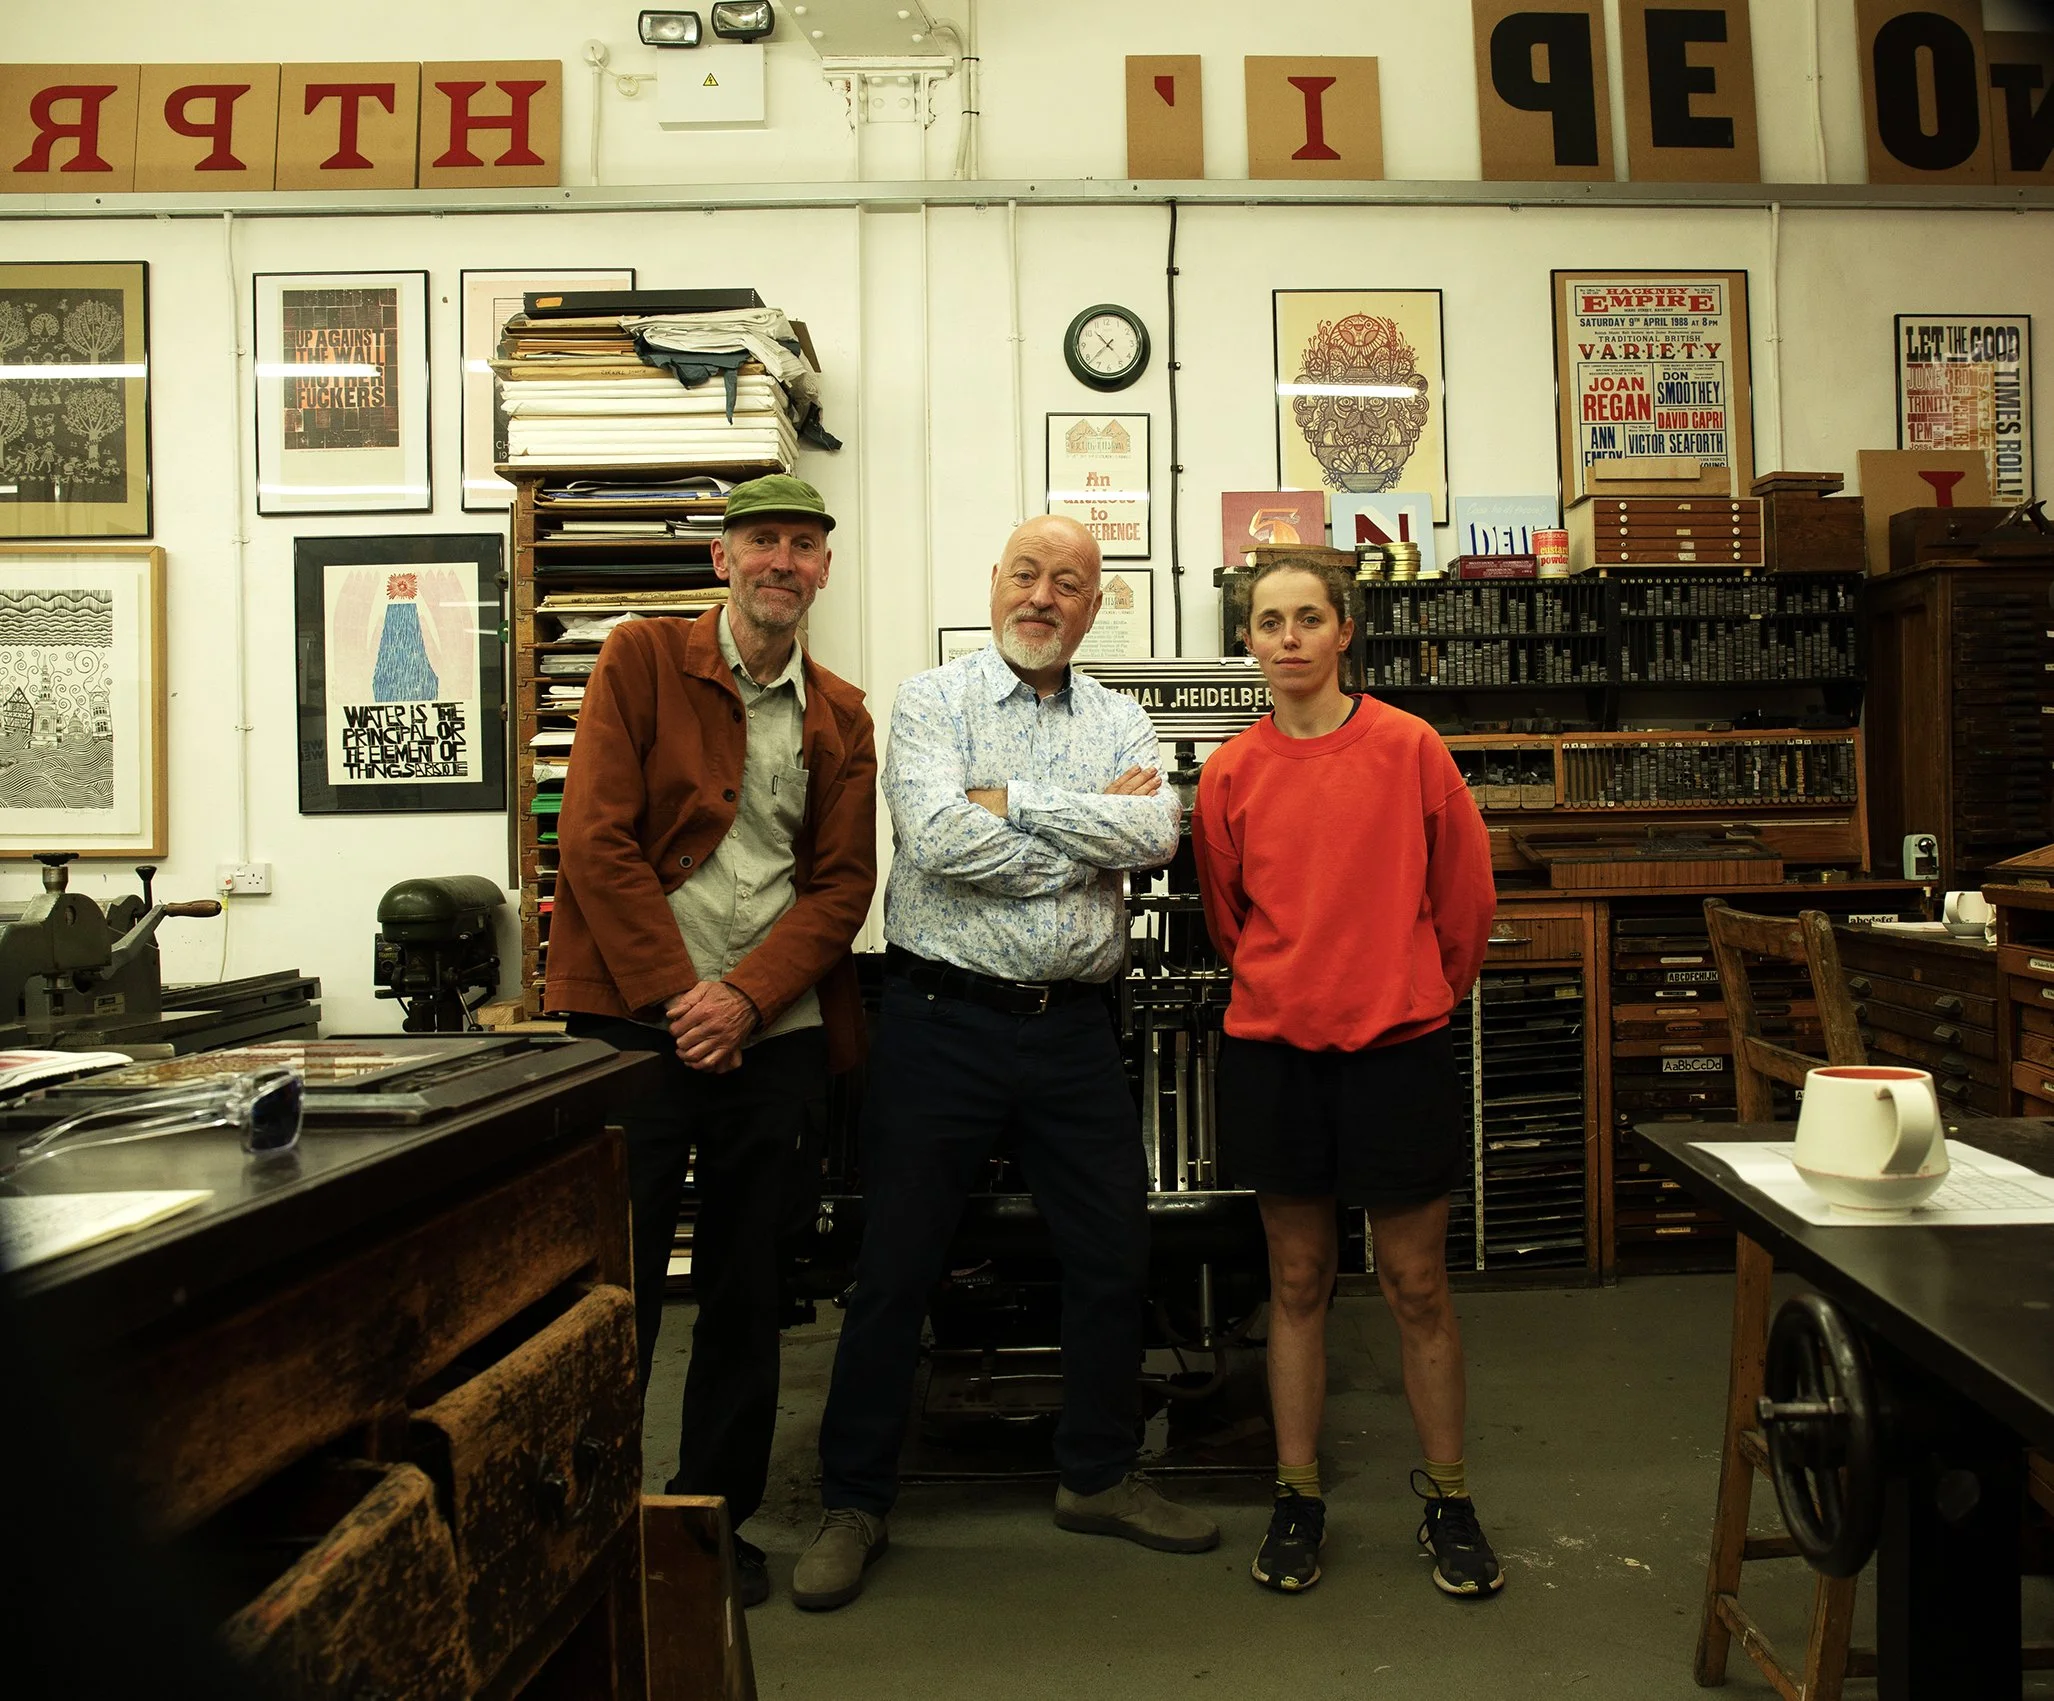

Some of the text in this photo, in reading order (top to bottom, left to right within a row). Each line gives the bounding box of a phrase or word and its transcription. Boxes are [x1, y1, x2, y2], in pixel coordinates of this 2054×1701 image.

[1582, 295, 1714, 313] EMPIRE
[1580, 318, 1625, 328] SATURDAY
[1643, 317, 1668, 327] APRIL
[1671, 317, 1689, 326] 1988
[295, 329, 385, 347] UP AGAINST
[1906, 326, 2020, 363] LET THE GOOD
[297, 347, 385, 366] THE WALL
[1588, 377, 1645, 392] JOAN
[1663, 372, 1689, 381] DON
[1907, 367, 1970, 395] JUNE 3RD
[297, 387, 385, 408] FUCKERS
[1657, 381, 1720, 405] SMOOTHEY
[1995, 368, 2021, 434] TIMES
[1583, 393, 1651, 422] REGAN
[1908, 395, 1952, 413] TRINITY
[1657, 411, 1723, 429] DAVID CAPRI
[1591, 426, 1615, 449] ANN
[1629, 433, 1723, 454] VICTOR SEAFORTH
[1085, 471, 1111, 487] An
[1090, 507, 1108, 521] to
[343, 705, 406, 729] WATER
[431, 702, 466, 722] THE
[436, 721, 467, 745] OR
[440, 740, 467, 762] OF
[1664, 1059, 1722, 1071] AaBbCcDd
